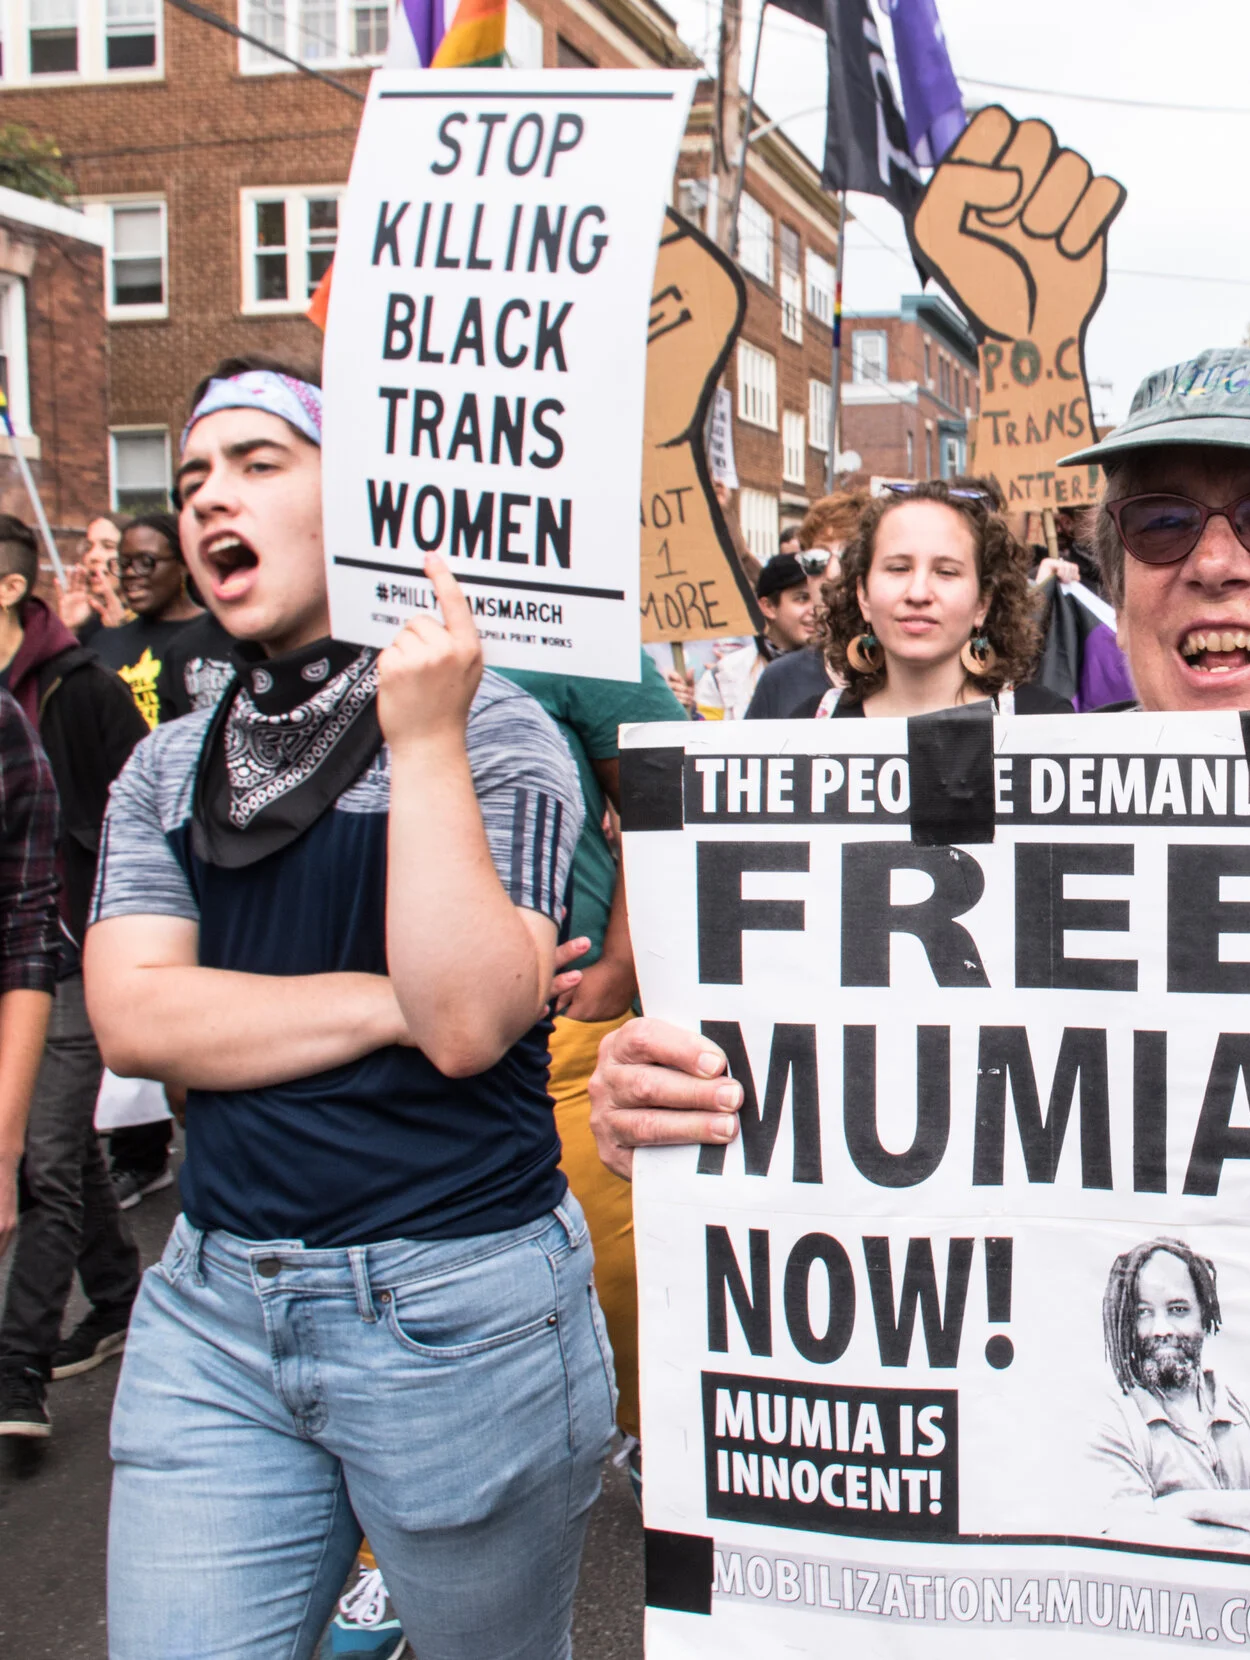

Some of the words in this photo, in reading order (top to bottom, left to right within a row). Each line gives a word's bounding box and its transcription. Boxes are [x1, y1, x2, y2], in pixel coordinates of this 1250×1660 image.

[430, 112, 584, 178] STOP
[371, 201, 609, 275] KILLING
[382, 292, 574, 373] BLACK
[378, 386, 565, 470] TRANS
[982, 397, 1086, 446] TRANS
[640, 486, 693, 529] OT
[989, 464, 1099, 502] ATTER!
[367, 479, 572, 569] WOMEN
[654, 537, 687, 579] 1
[375, 582, 563, 626] #PHILLYNSMARCH
[509, 632, 537, 645] PRINT
[540, 636, 573, 649] WORKS
[695, 758, 795, 813] THE
[811, 757, 1014, 814] PEOE
[705, 1224, 1015, 1370] NOW!
[715, 1388, 886, 1454] MUMIA
[899, 1405, 946, 1457] IS
[717, 1449, 942, 1515] INNOCENT!
